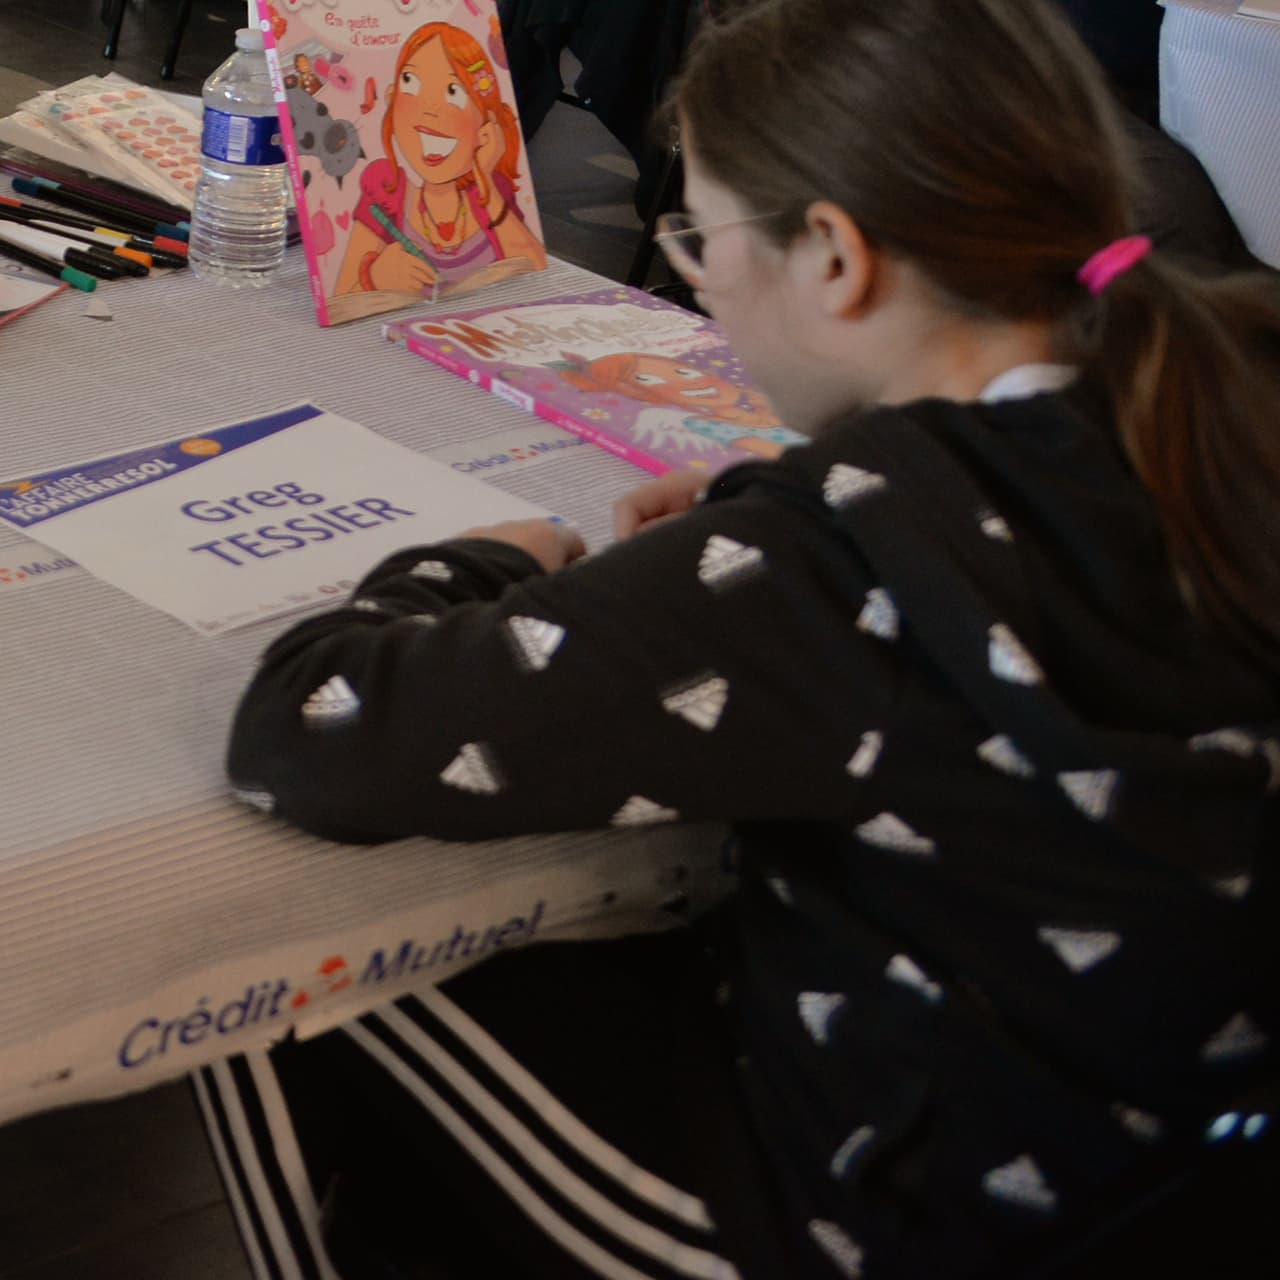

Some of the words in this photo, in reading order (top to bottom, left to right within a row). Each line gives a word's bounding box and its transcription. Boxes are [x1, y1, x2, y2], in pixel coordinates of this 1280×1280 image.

[12, 457, 178, 522] TONNERRESOL
[179, 480, 326, 543] Greg
[189, 496, 417, 567] TESSIER
[19, 556, 81, 577] Mutu
[117, 977, 293, 1069] Crédit
[359, 900, 546, 987] Mutuel
